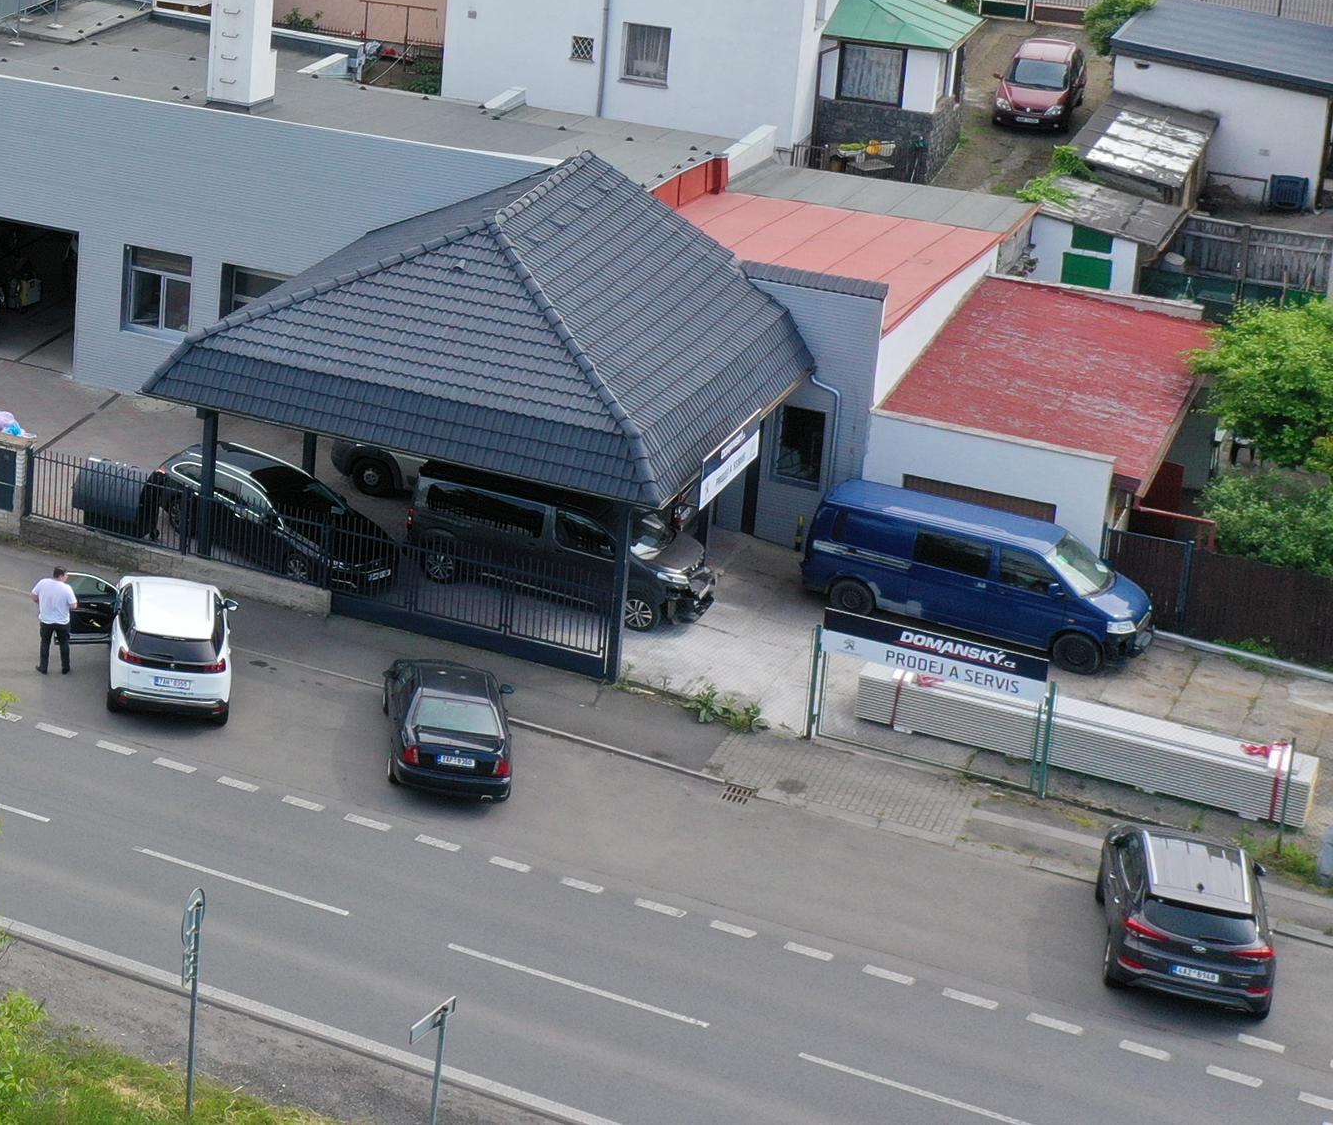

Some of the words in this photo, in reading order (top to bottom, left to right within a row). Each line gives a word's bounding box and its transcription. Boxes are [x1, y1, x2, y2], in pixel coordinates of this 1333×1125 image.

[885, 649, 944, 675] PRODEJ
[949, 666, 959, 679] A
[964, 669, 1020, 694] SERVIS
